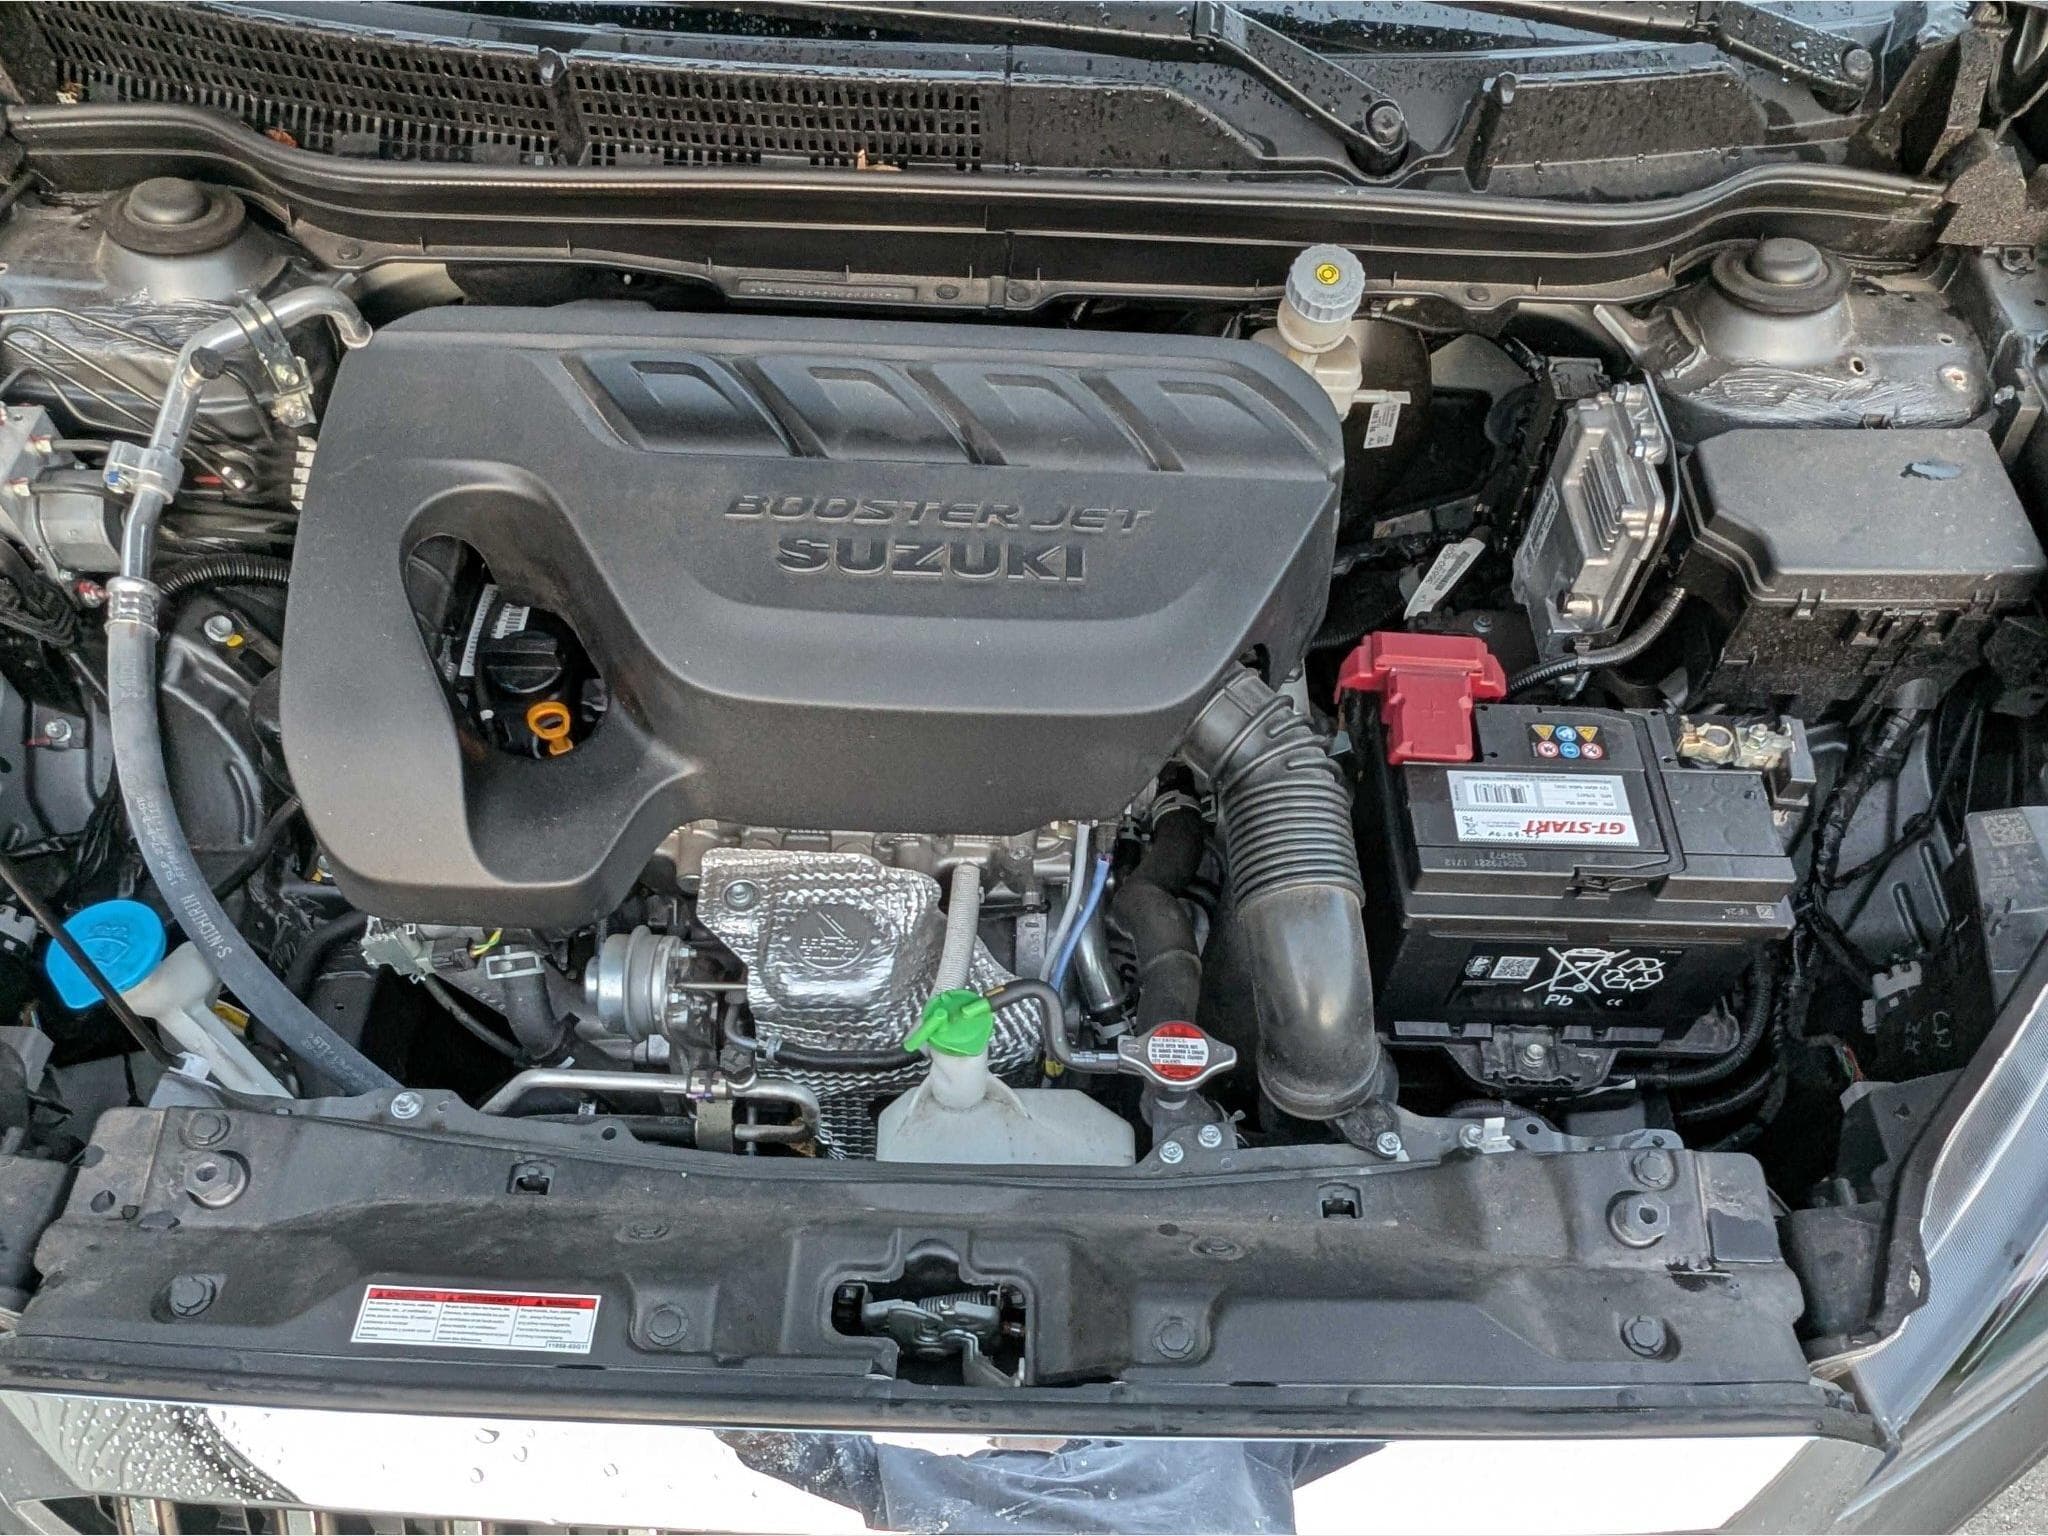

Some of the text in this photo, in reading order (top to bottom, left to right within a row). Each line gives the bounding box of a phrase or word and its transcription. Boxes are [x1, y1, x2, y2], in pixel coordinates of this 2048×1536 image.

[776, 536, 1088, 583] SUZUKI
[1522, 818, 1626, 836] GT-START
[1543, 993, 1575, 1007] Pb
